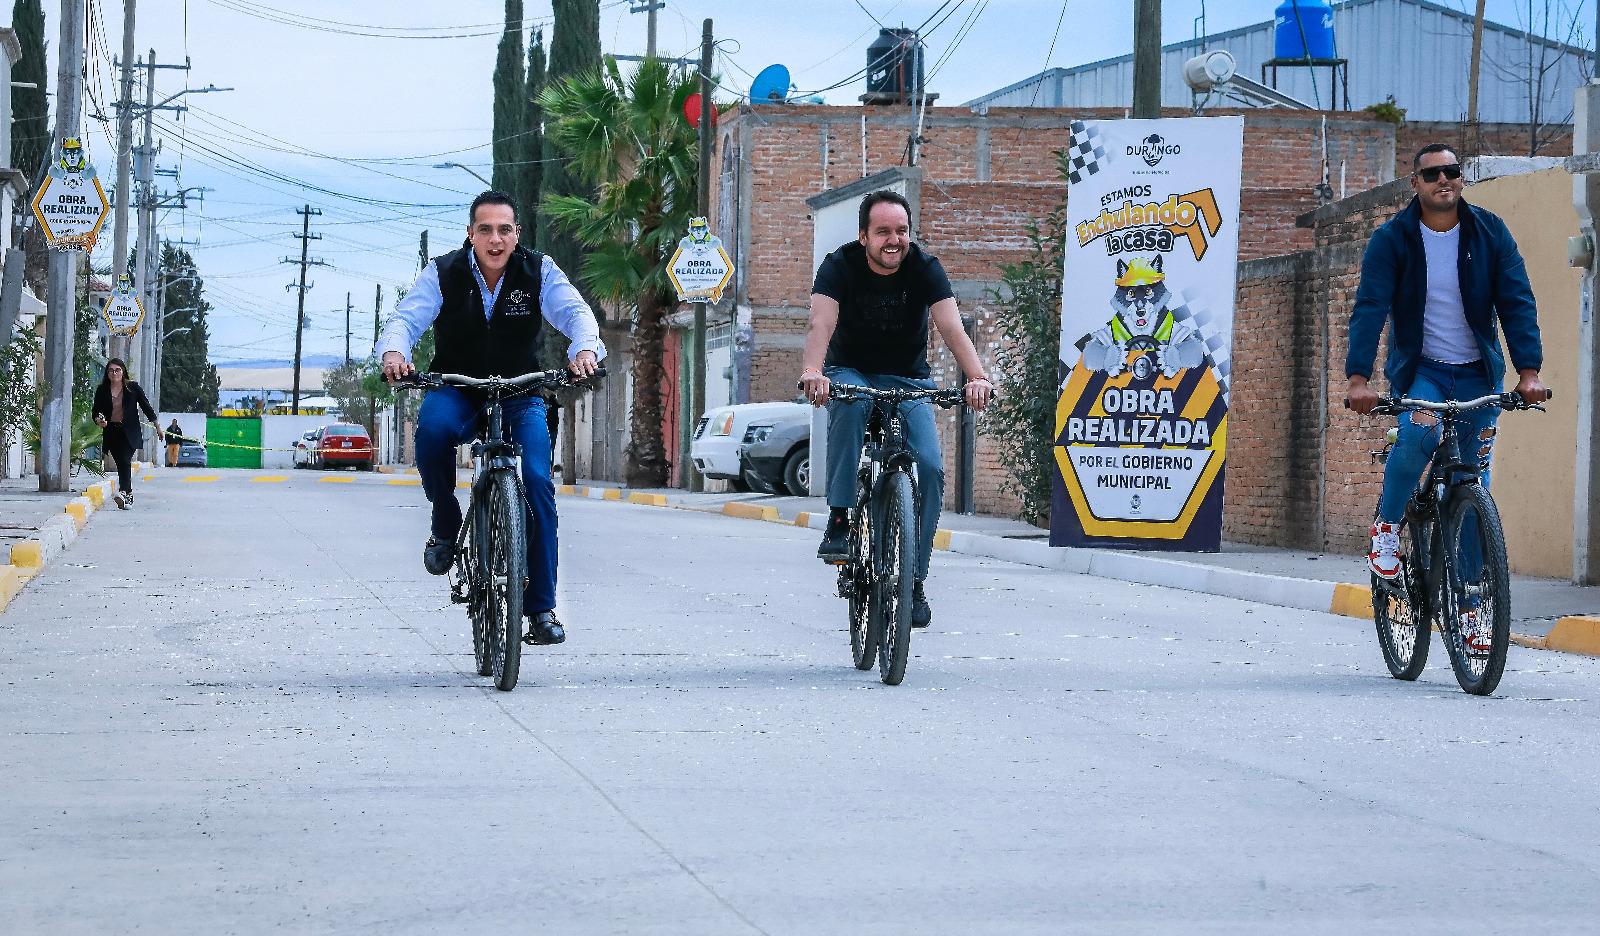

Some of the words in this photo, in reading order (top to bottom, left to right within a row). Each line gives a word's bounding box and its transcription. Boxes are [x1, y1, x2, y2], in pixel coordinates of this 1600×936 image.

[58, 194, 87, 205] OBRA
[1100, 185, 1152, 206] ESTAMOS
[43, 204, 100, 216] REALIZADA
[1077, 194, 1197, 247] Enchulando
[1106, 233, 1122, 256] la
[1122, 229, 1174, 252] casa
[687, 260, 712, 268] OBRA
[1103, 388, 1175, 414] OBRA
[1068, 417, 1211, 445] REALIZADA
[1079, 455, 1102, 468] POR
[1105, 456, 1119, 469] EL
[1122, 455, 1193, 470] GOBIERNO
[1097, 474, 1172, 490] MUNICIPAL
